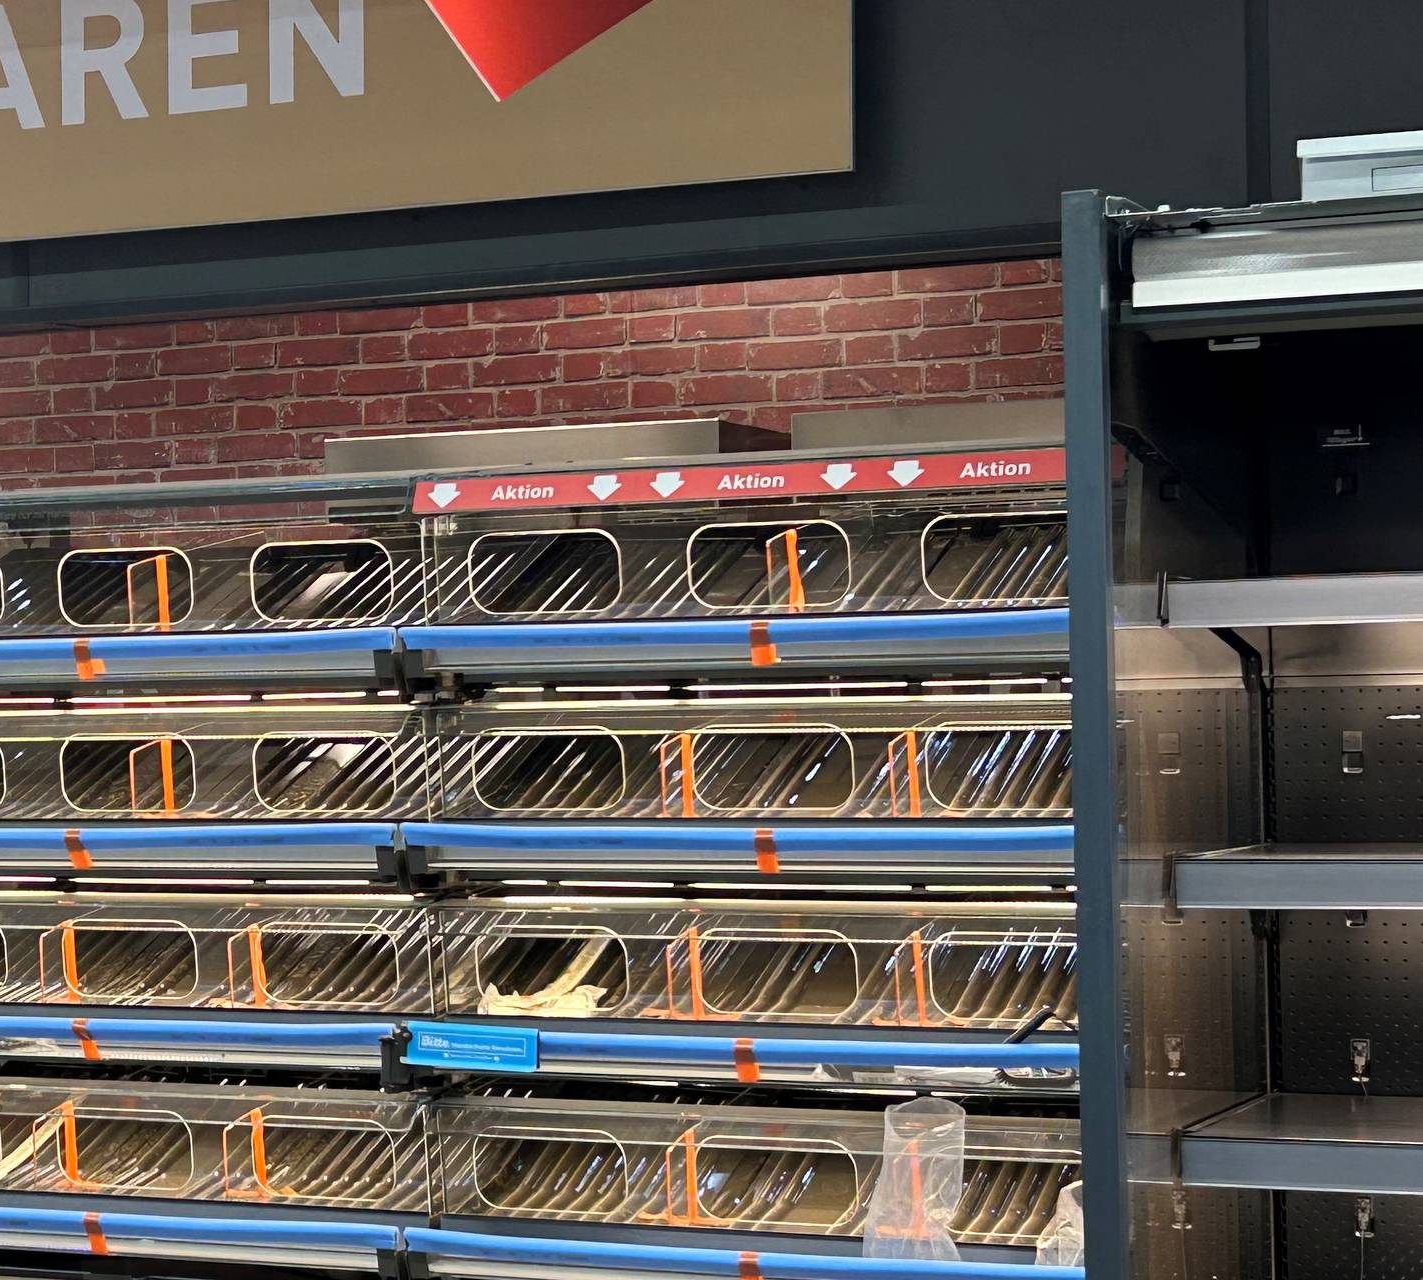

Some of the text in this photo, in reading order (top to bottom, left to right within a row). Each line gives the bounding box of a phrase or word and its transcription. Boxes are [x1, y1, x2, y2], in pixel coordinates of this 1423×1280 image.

[490, 460, 1032, 501] Aktion Aktion Aktion
